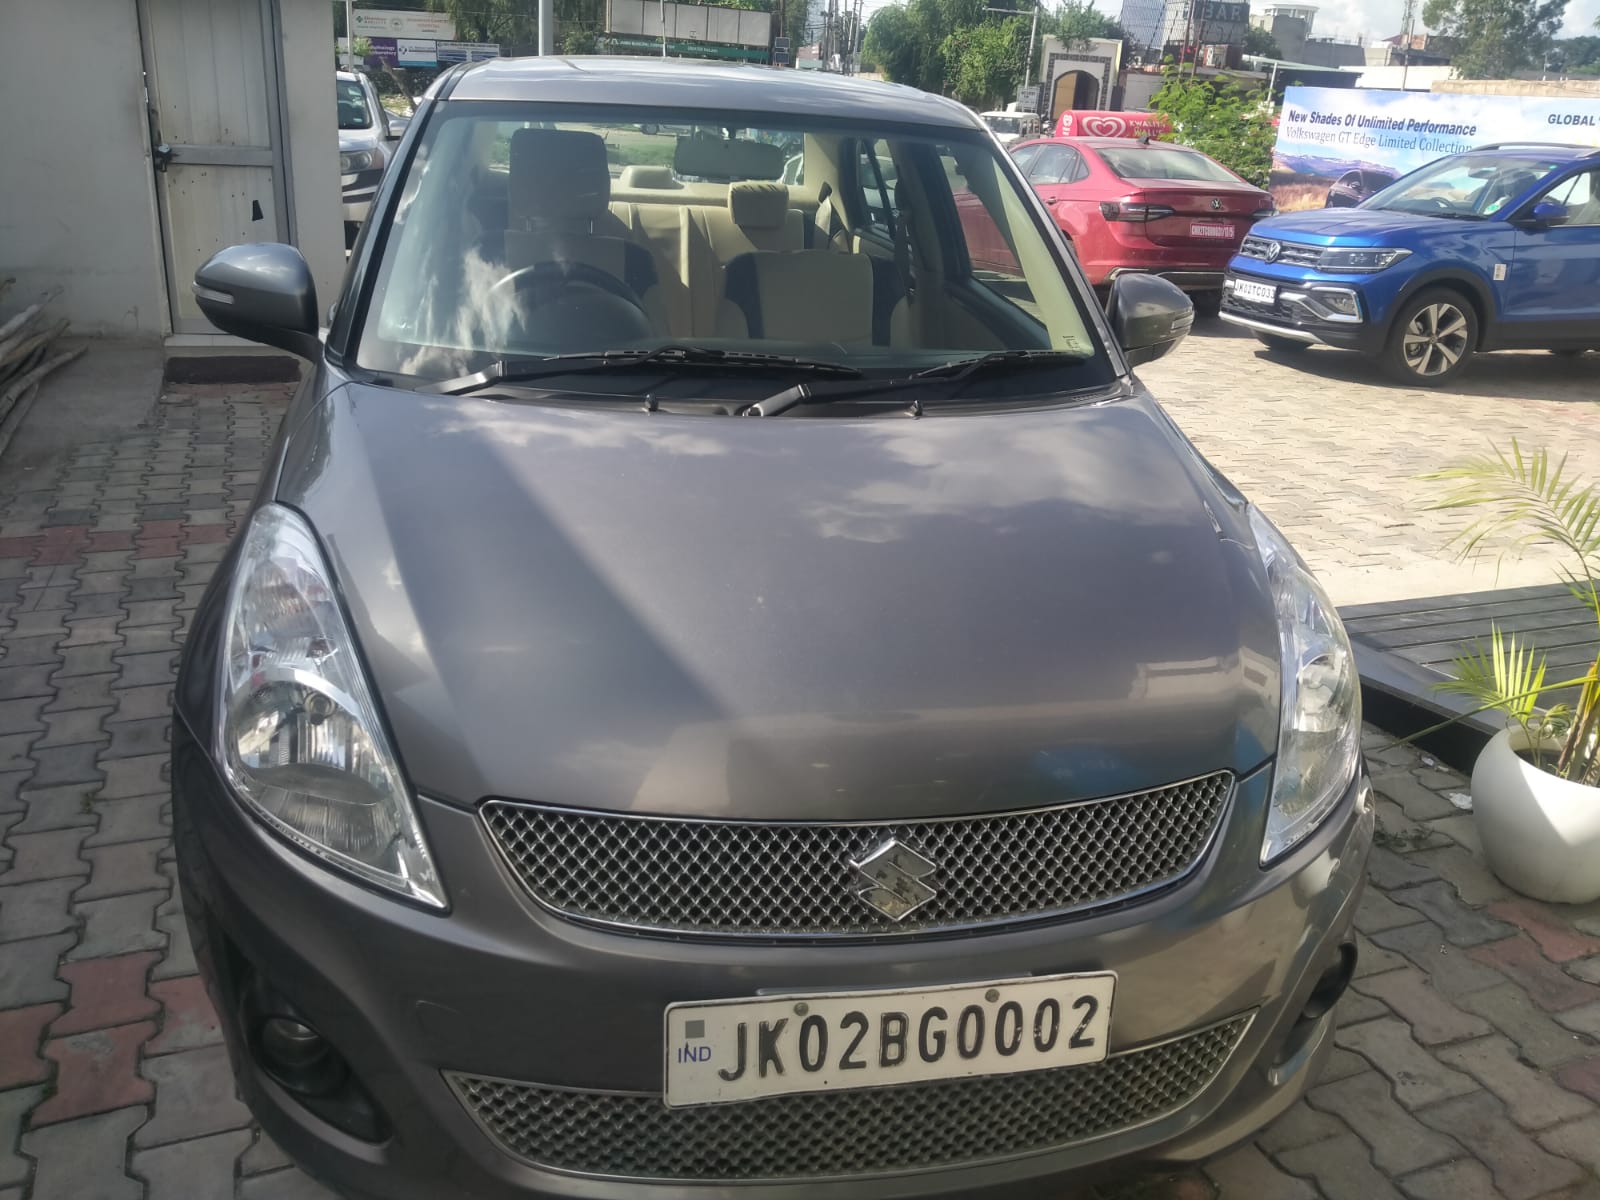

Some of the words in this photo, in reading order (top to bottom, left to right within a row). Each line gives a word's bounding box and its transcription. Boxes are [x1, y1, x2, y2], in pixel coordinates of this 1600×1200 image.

[1287, 109, 1308, 122] New
[1309, 111, 1342, 126] Shades
[1344, 114, 1356, 127] Of
[1357, 115, 1405, 131] Unlimited
[1406, 118, 1477, 136] Performance
[1547, 113, 1596, 127] GLOBAL
[1286, 126, 1336, 144] Volkswagen
[1338, 131, 1352, 144] GT
[1353, 133, 1377, 148] Edge
[1378, 134, 1417, 150] Limited
[1418, 137, 1472, 154] Collection
[718, 995, 1099, 1081] JK02BG0002
[677, 1045, 712, 1063] IND
